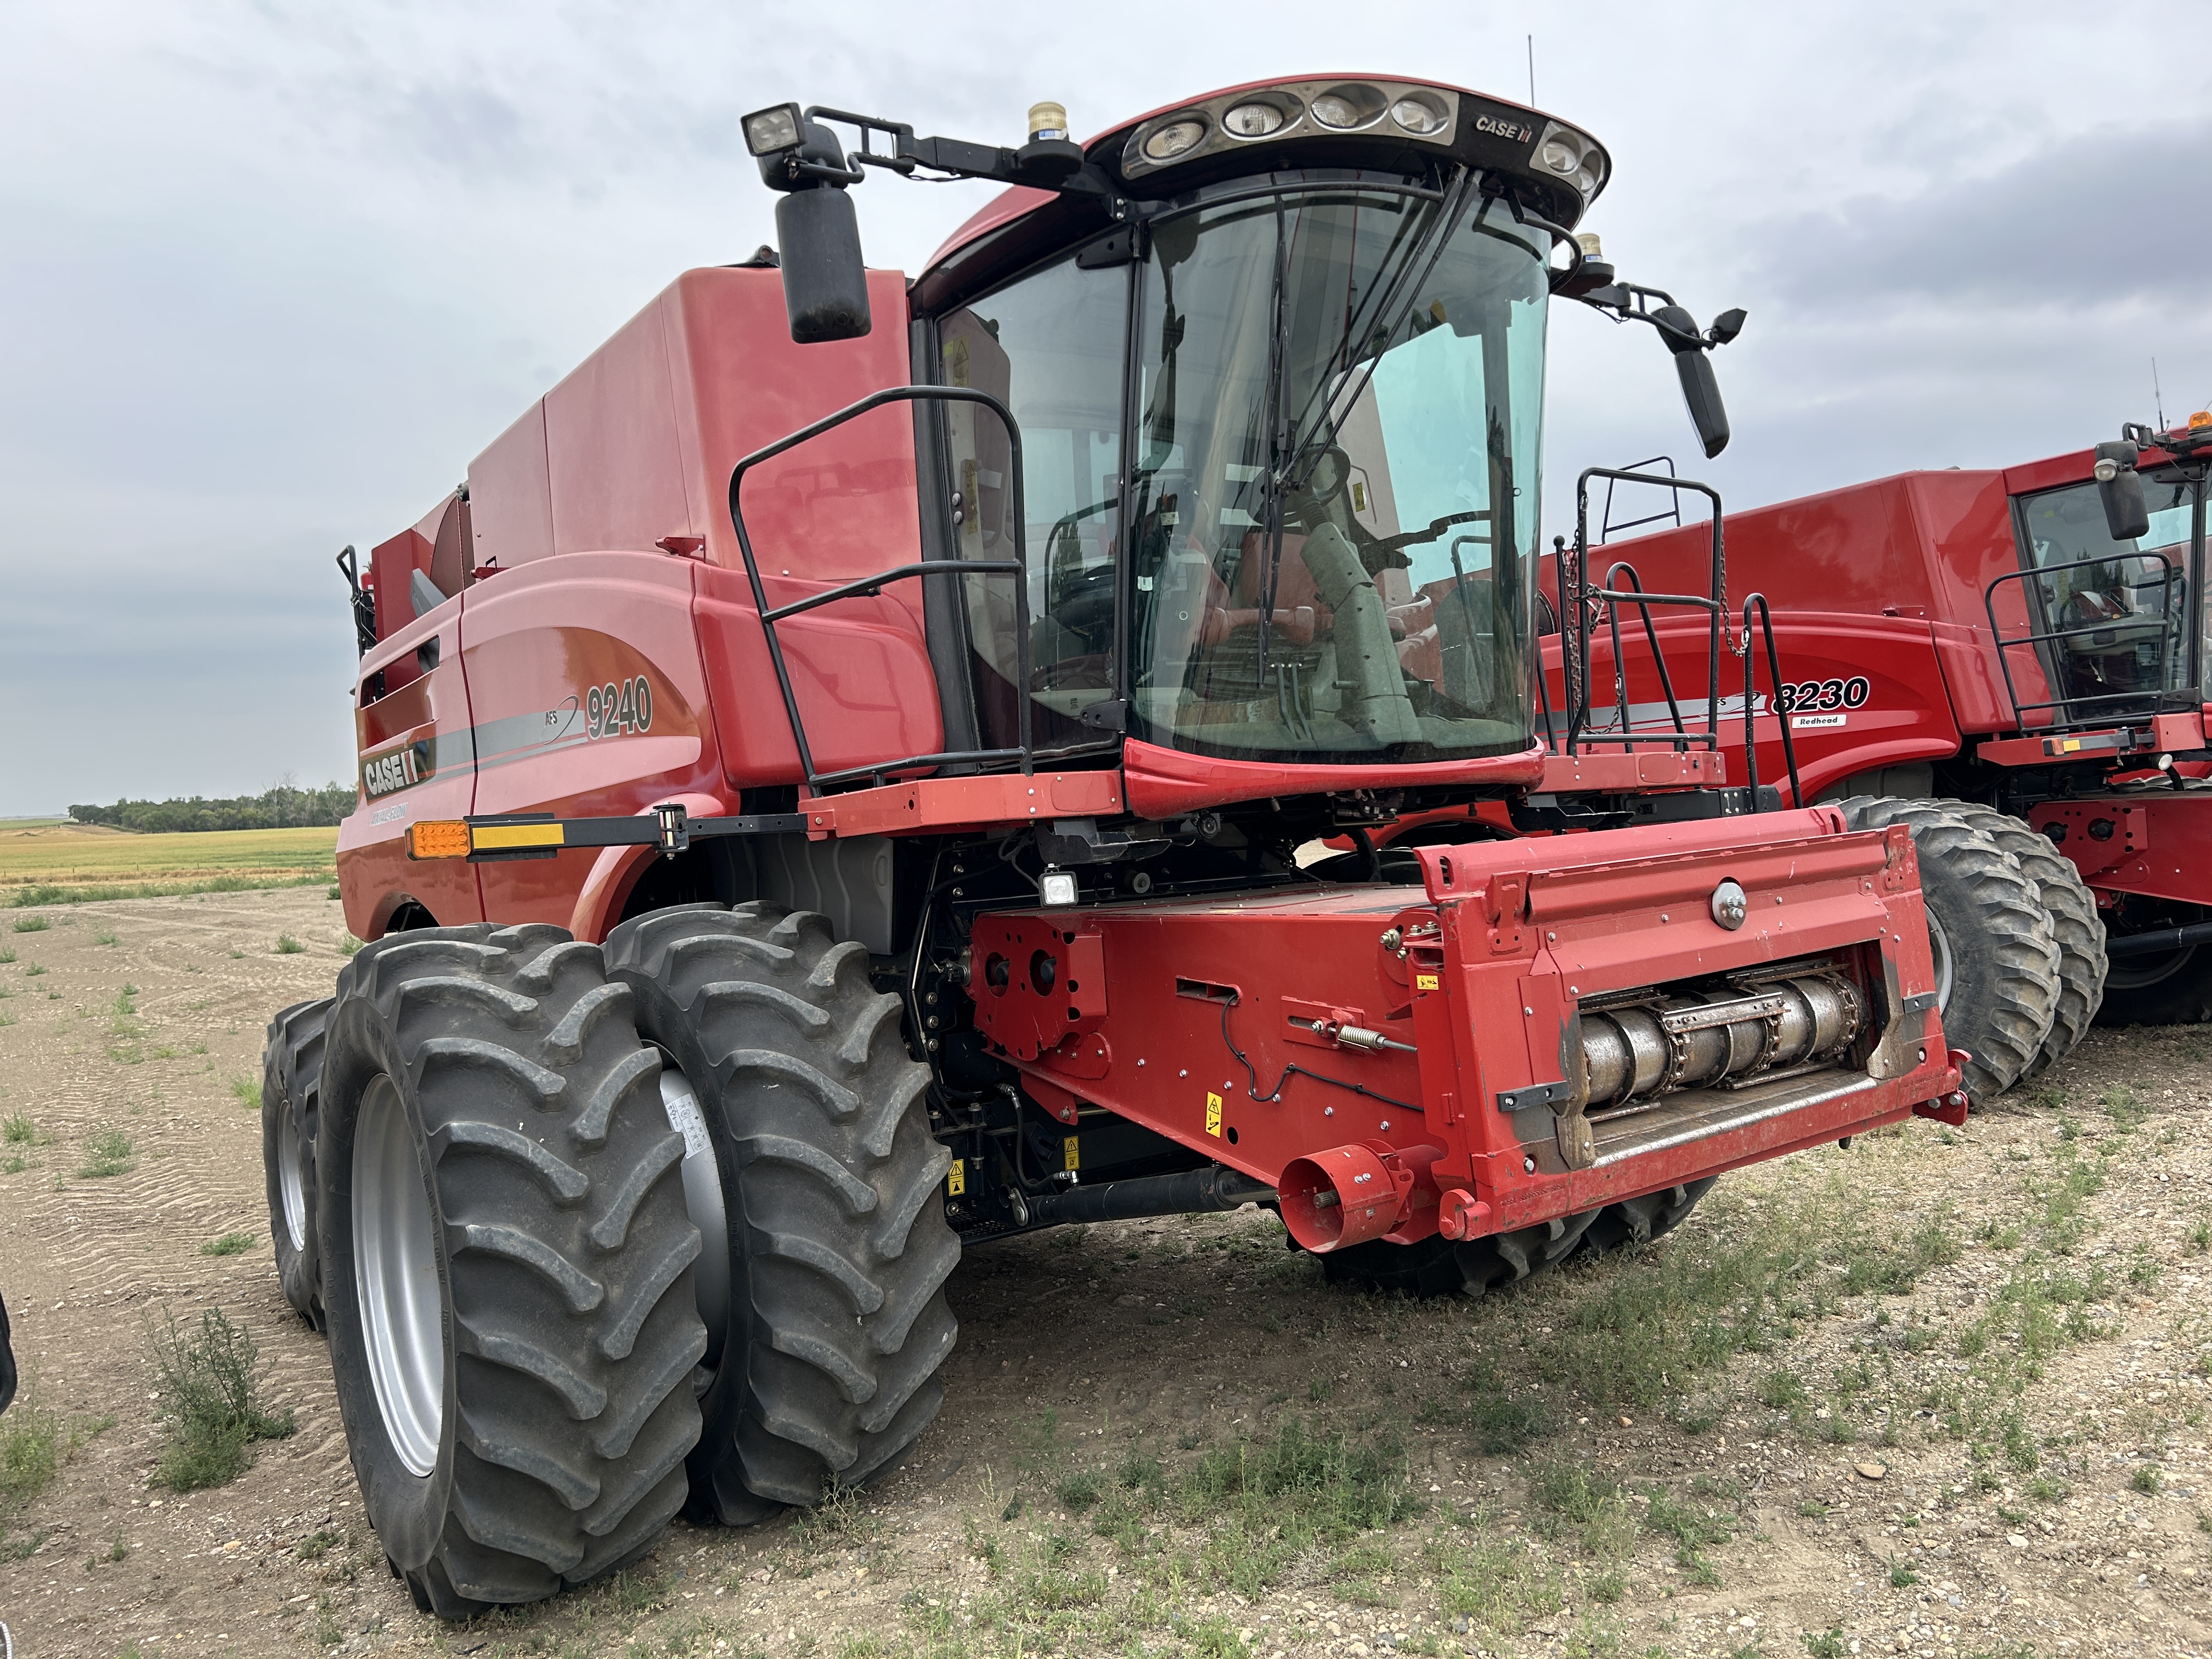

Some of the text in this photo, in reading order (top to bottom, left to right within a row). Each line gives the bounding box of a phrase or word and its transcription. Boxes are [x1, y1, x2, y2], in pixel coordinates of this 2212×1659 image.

[1476, 116, 1517, 138] CASE
[587, 675, 652, 740] 9240
[1771, 676, 1870, 714] 8230
[545, 710, 557, 725] AFS
[1800, 716, 1838, 725] Redhead
[366, 754, 405, 795] CASE
